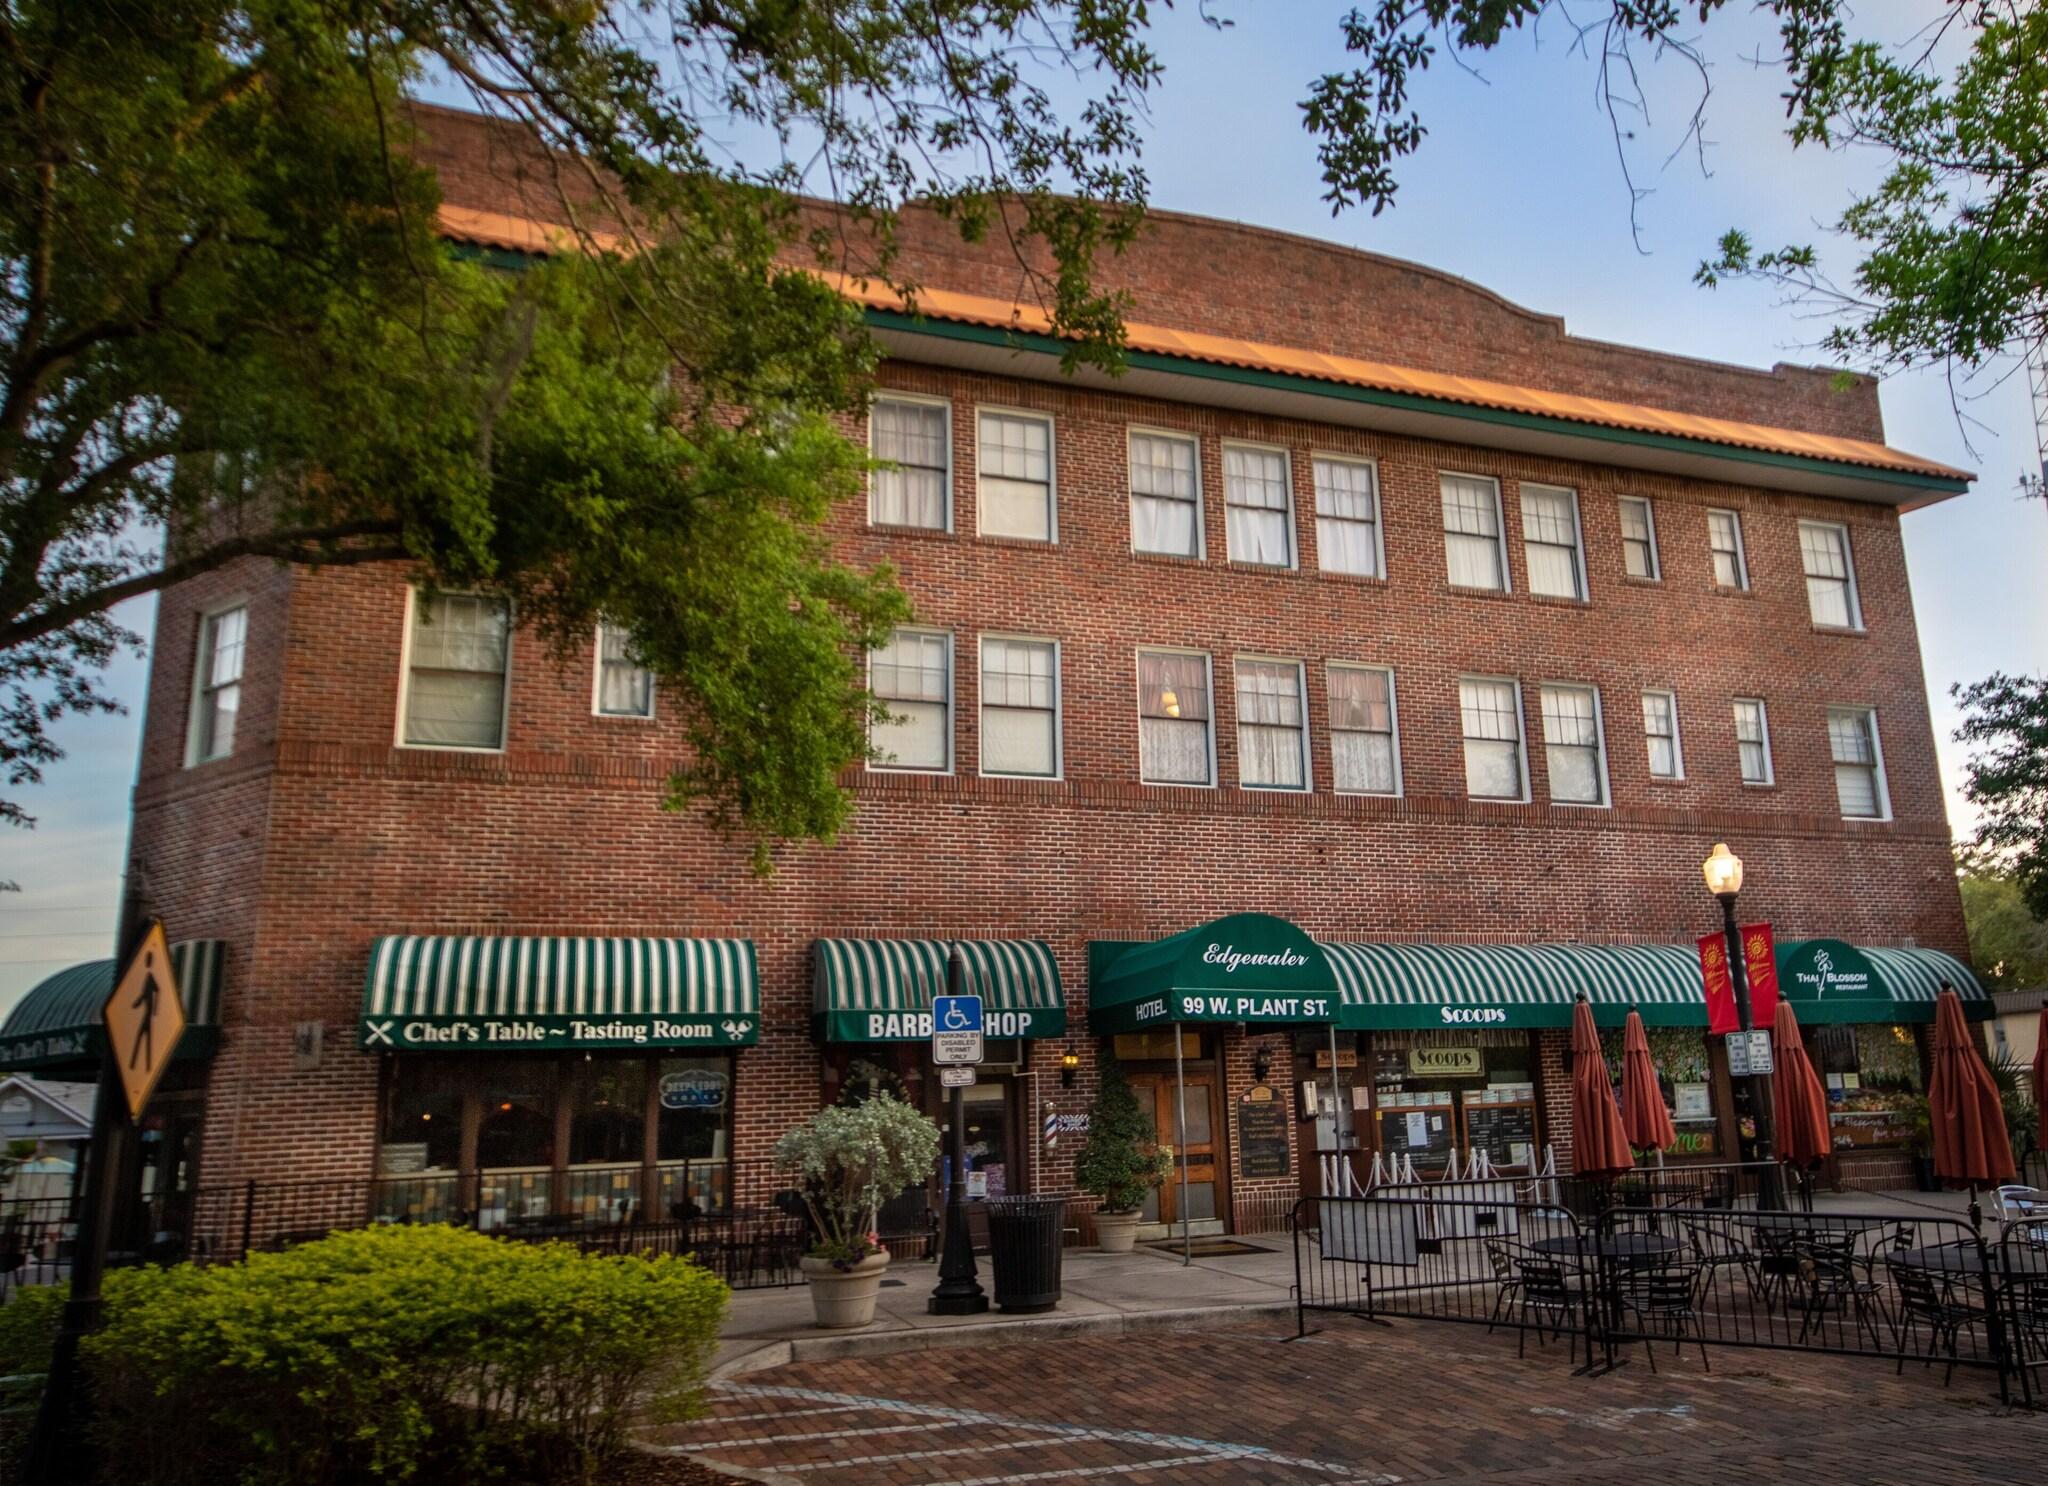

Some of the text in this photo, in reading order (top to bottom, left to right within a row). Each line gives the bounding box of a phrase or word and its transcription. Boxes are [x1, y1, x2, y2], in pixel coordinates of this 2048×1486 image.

[1202, 943, 1309, 973] Edgewater
[1135, 999, 1167, 1021] HOTEL
[1183, 997, 1330, 1017] 99 W. PLANT ST.
[403, 1021, 480, 1042] Chef's
[484, 1021, 546, 1042] Table
[569, 1020, 649, 1044] Tasting
[652, 1020, 714, 1039] Room
[868, 1013, 933, 1038] BARB
[941, 1039, 977, 1047] DISABLED
